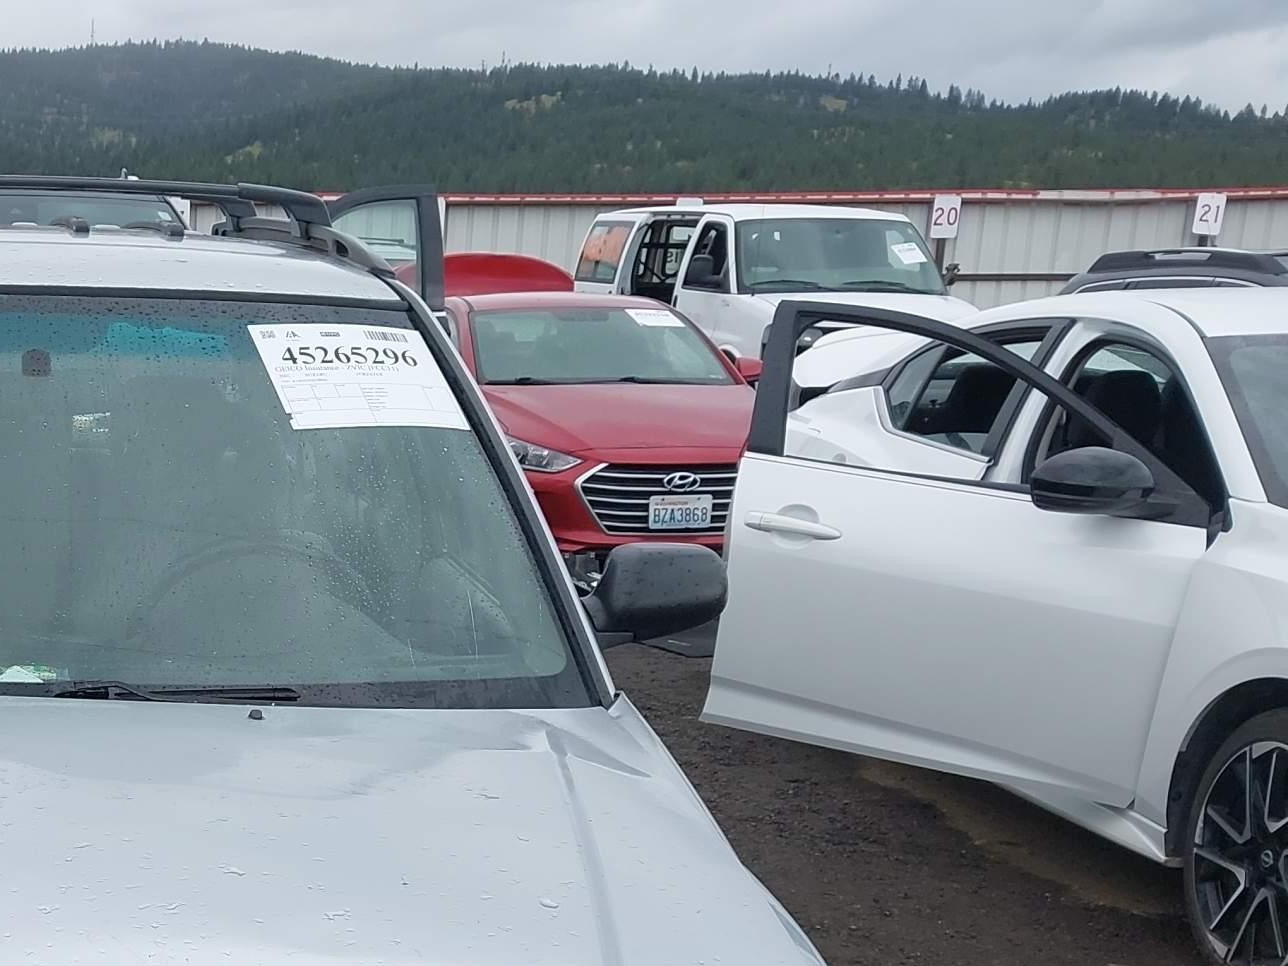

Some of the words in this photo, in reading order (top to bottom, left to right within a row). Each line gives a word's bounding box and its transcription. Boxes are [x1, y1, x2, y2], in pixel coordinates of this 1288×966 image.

[933, 207, 958, 226] 20
[1199, 204, 1220, 223] 21
[281, 346, 418, 367] 45265296
[653, 507, 708, 524] BZA3868
